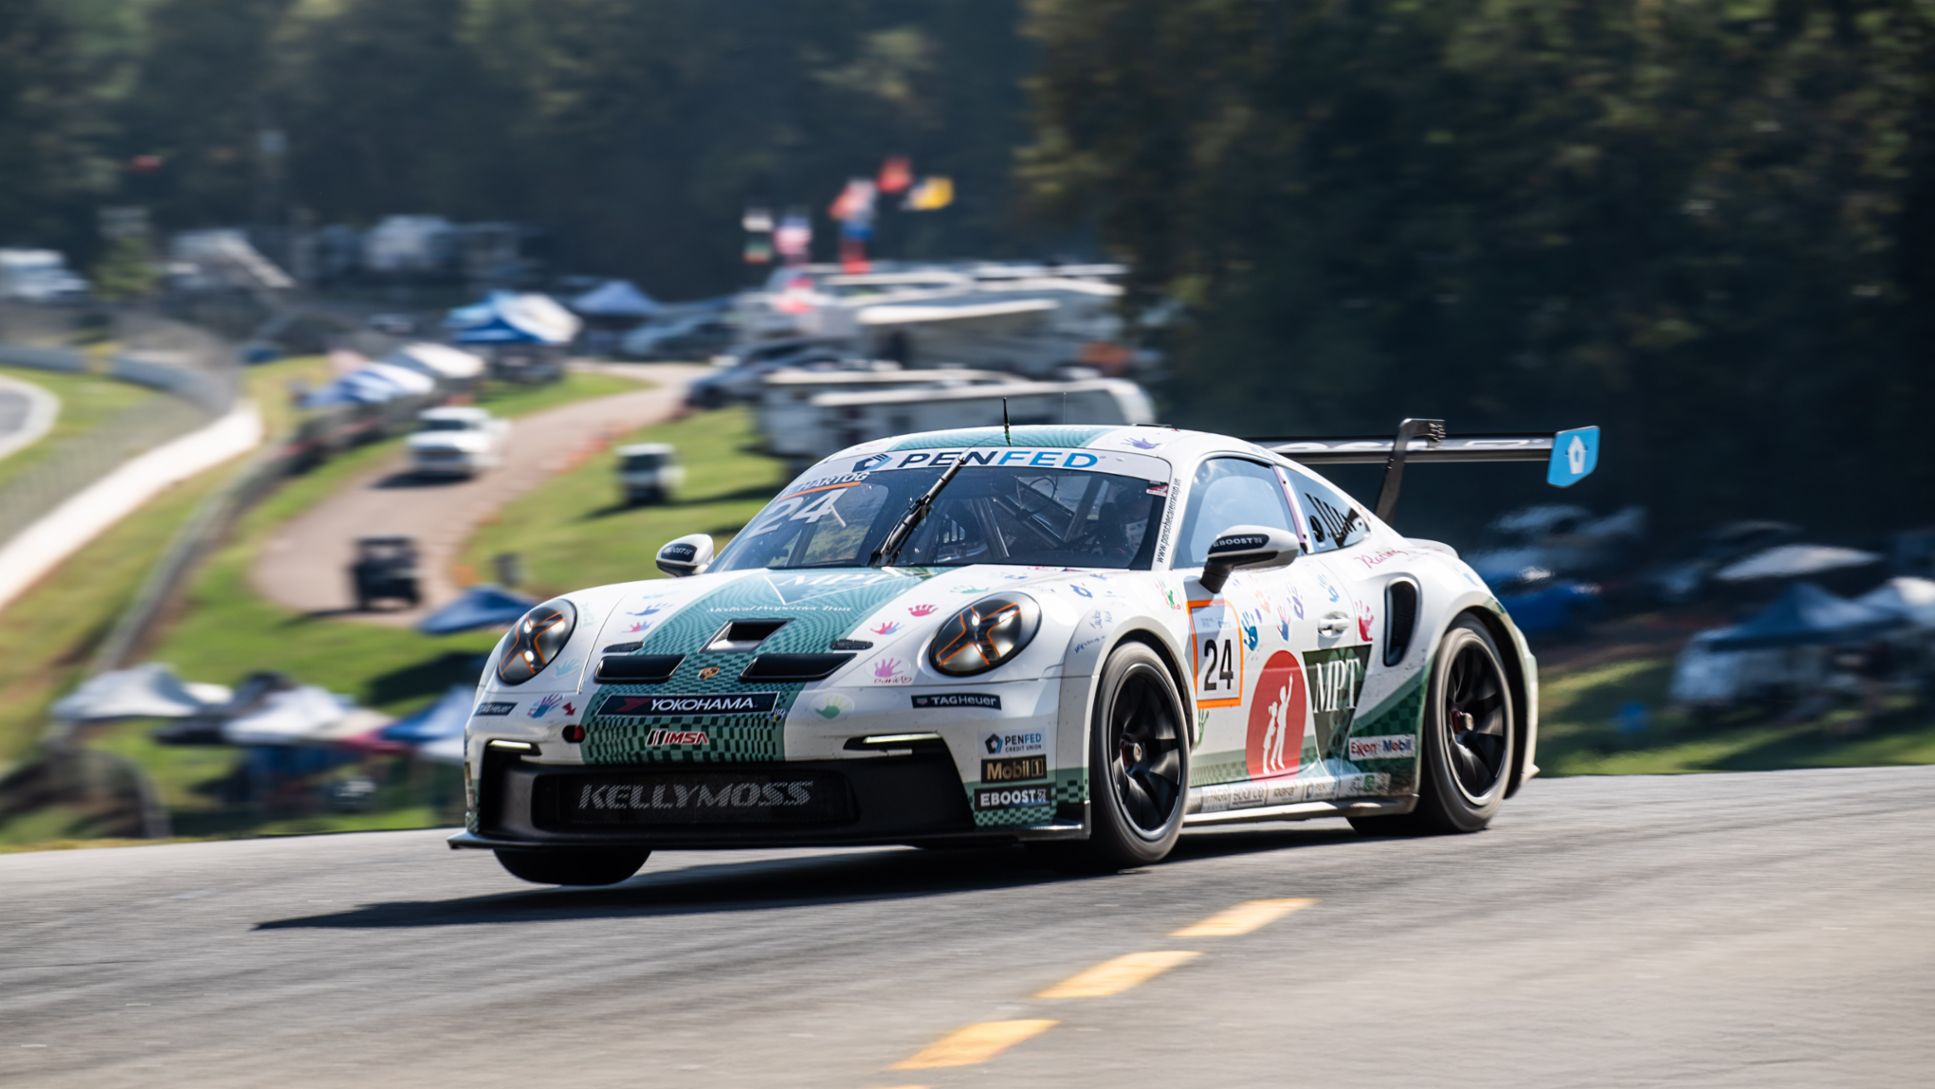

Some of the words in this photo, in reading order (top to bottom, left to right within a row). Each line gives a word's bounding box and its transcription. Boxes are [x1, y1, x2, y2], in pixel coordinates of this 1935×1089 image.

[897, 450, 1099, 469] PENFED
[742, 487, 849, 540] 24
[1203, 639, 1234, 691] 24
[1313, 658, 1361, 714] MPT
[650, 697, 754, 711] YOKOHAMA
[664, 732, 709, 744] IMSA
[1004, 733, 1042, 745] PENFED
[987, 760, 1030, 780] Mobil
[578, 781, 814, 809] KELLYMOSS
[980, 788, 1036, 807] EBOOST
